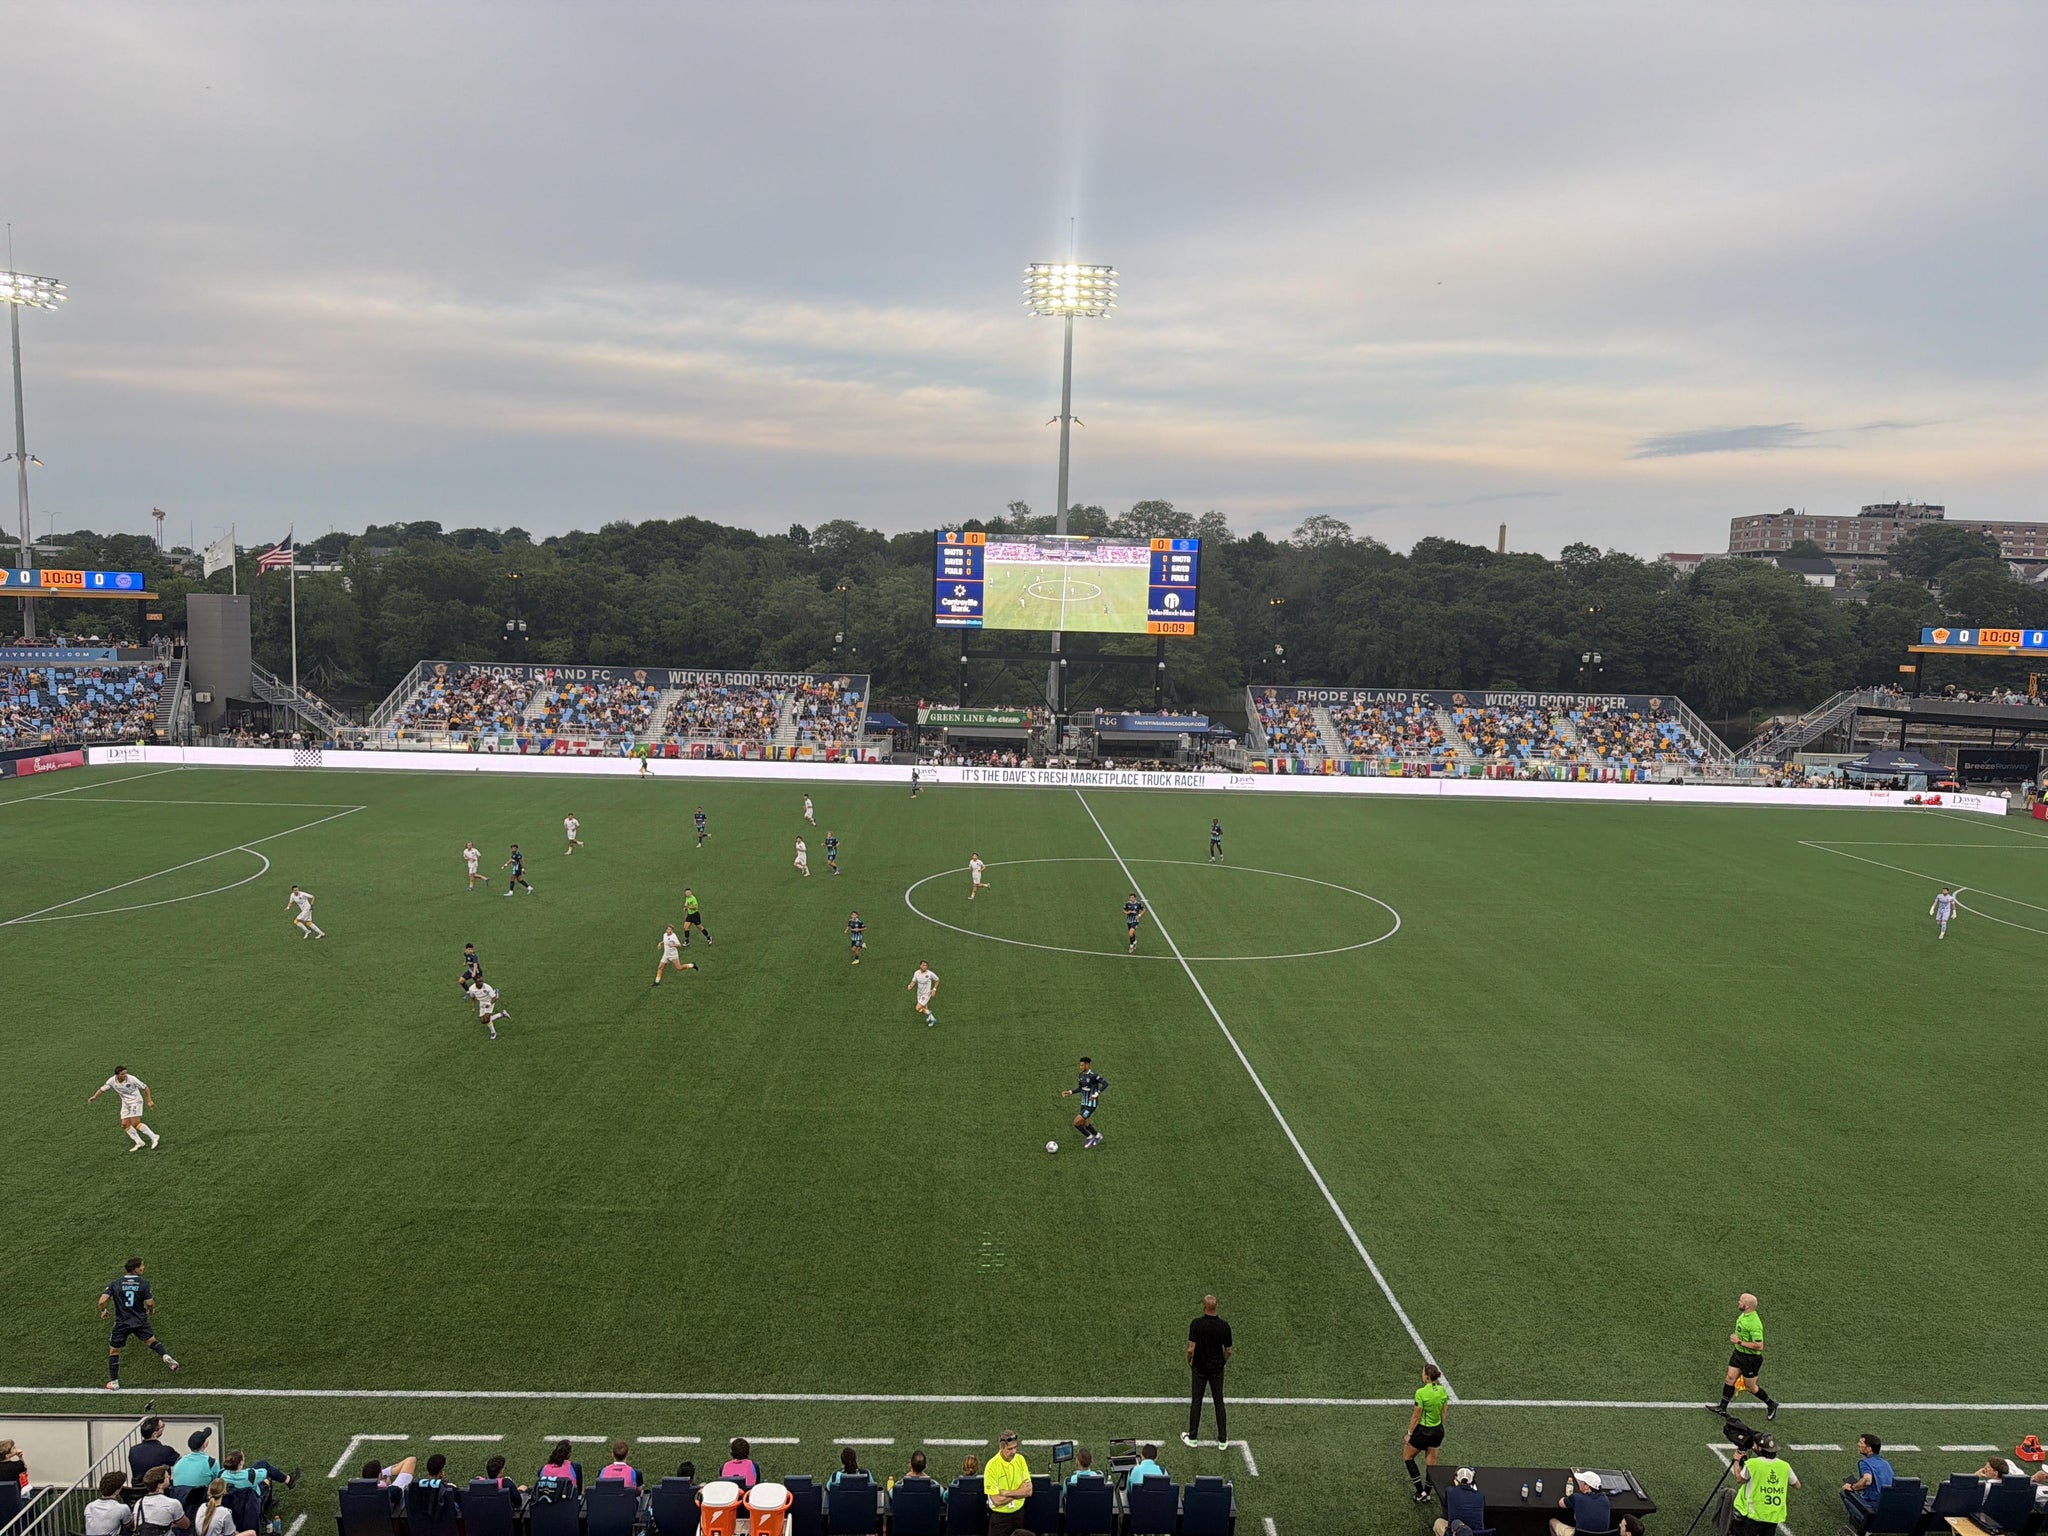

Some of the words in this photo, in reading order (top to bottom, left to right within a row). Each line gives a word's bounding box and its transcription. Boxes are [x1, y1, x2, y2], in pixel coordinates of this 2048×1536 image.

[971, 533, 978, 544] 0
[1157, 539, 1164, 549] 0
[944, 567, 963, 575] FOULS
[20, 571, 31, 584] 0
[43, 572, 82, 584] 10:09
[95, 573, 104, 585] 0
[1156, 623, 1185, 633] 10:09
[1960, 630, 1969, 642] 0
[1982, 631, 2020, 643] 10:09
[2033, 632, 2042, 644] 0
[592, 669, 611, 680] FC
[668, 671, 721, 684] WICKED
[725, 672, 760, 686] GOOD
[1297, 690, 1348, 702] RHODE
[1353, 691, 1407, 703] ISLAND
[1412, 693, 1429, 703] FC
[1485, 693, 1536, 706] WICKED
[930, 713, 961, 722] GREEN
[963, 714, 984, 723] LINE
[962, 769, 980, 781] IT'S
[986, 770, 1000, 782] THE
[1002, 771, 1035, 782] DAVE'S
[1038, 771, 1068, 783] FRESH
[1071, 772, 1138, 786] MARKETPLACE
[1142, 774, 1171, 787] TRUCK
[1174, 774, 1205, 788] RACE!!
[124, 1290, 135, 1307] 3
[1760, 1486, 1784, 1494] HOME
[1764, 1495, 1781, 1506] 30
